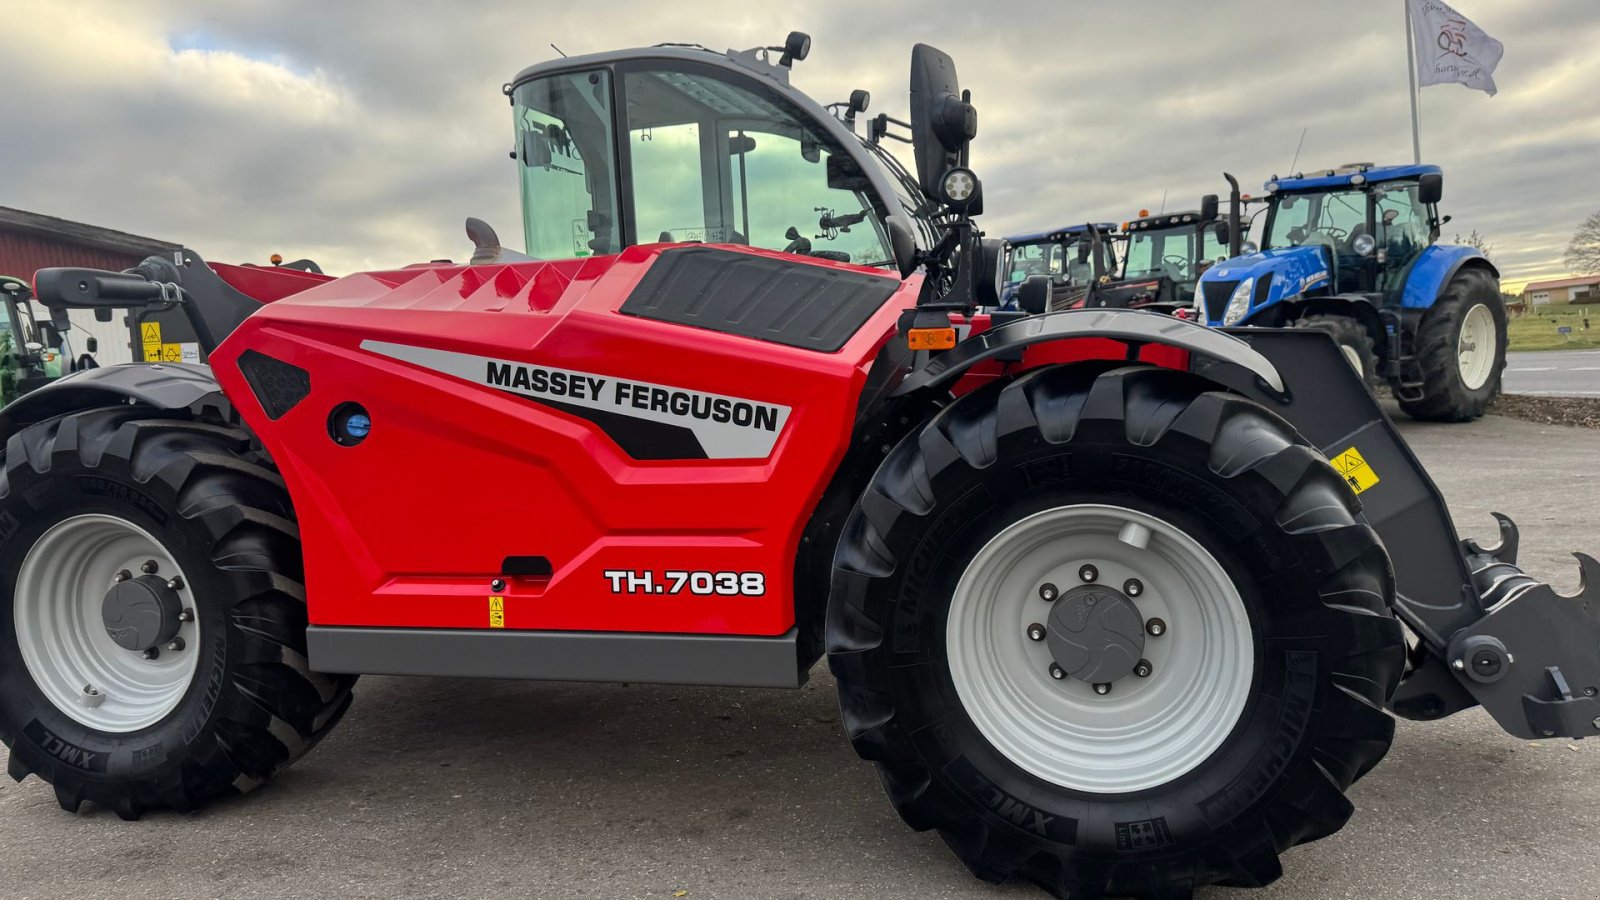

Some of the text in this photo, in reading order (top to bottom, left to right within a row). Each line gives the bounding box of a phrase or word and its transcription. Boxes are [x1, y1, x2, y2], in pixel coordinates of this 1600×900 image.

[486, 361, 779, 432] MASSEY FERGUSON
[603, 569, 766, 596] TH.7038
[39, 731, 96, 770] XMCL
[972, 775, 1055, 836] XMCL
